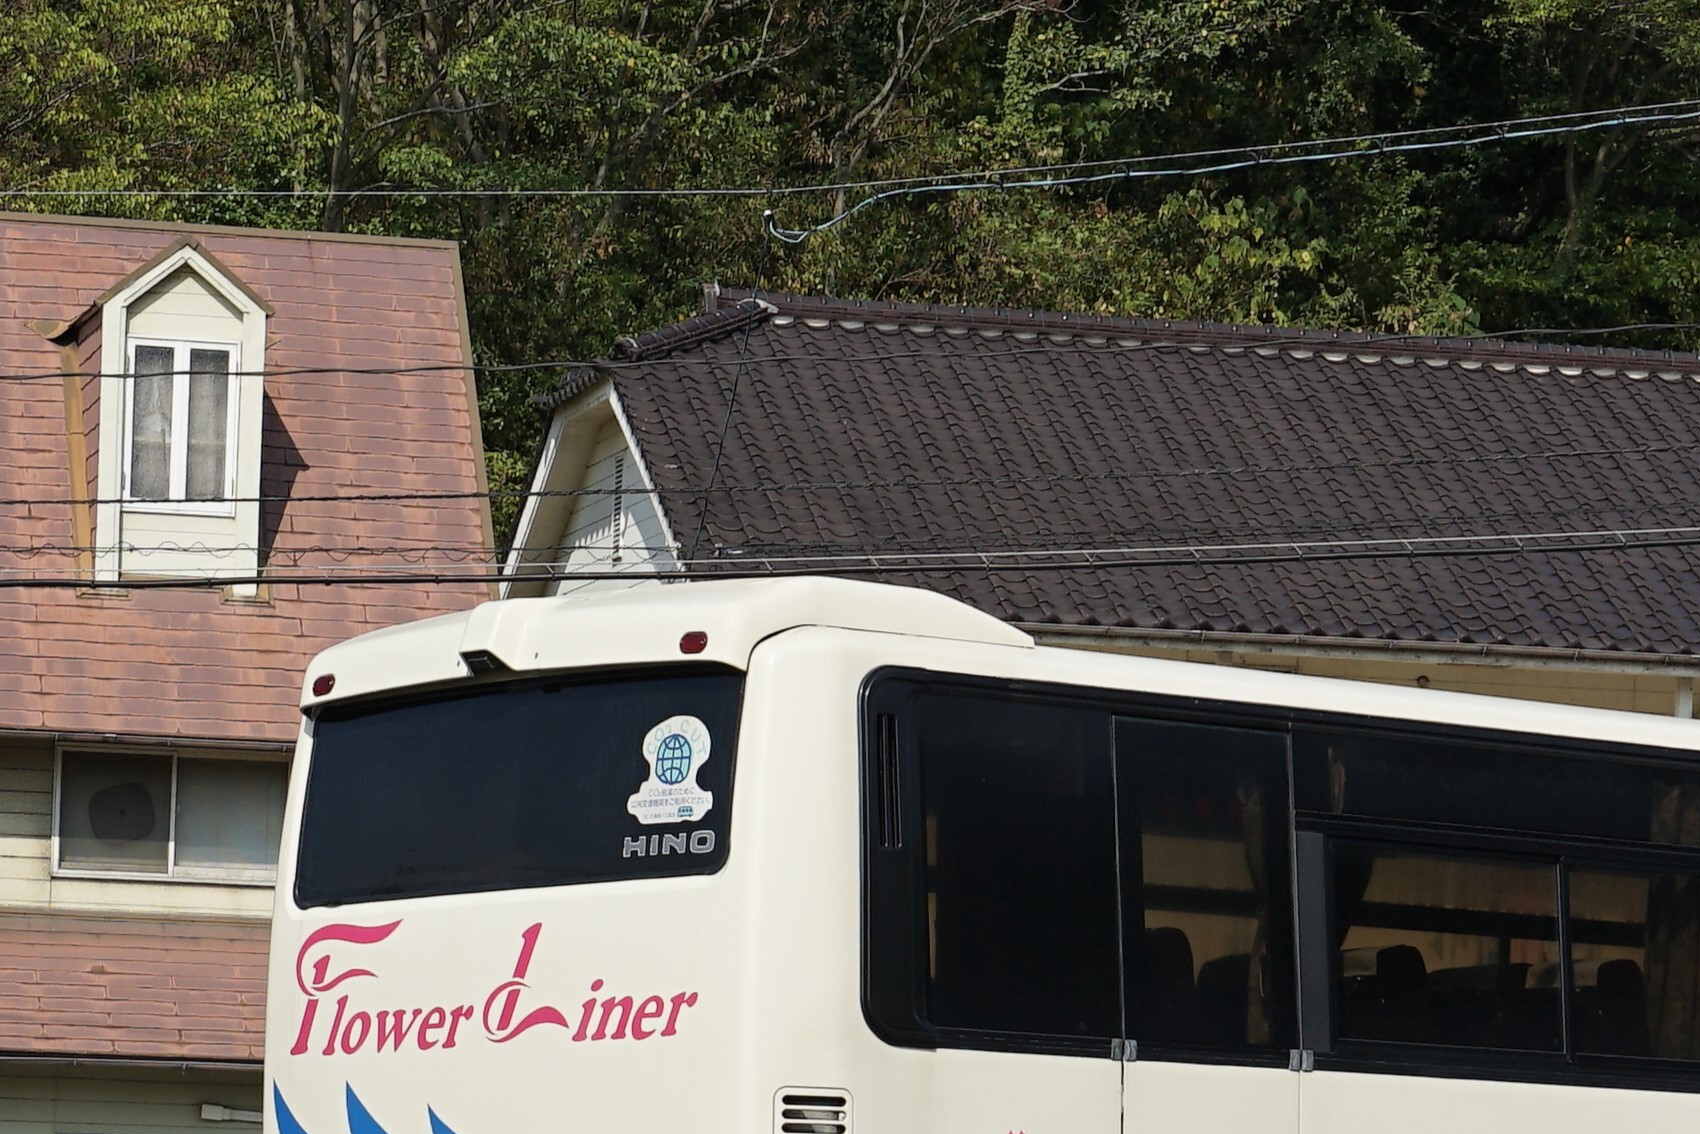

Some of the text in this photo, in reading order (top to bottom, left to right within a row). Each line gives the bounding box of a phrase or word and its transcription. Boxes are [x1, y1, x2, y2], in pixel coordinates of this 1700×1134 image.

[680, 719, 708, 755] CUT
[623, 830, 716, 858] HINO
[290, 918, 699, 1057] Flower Liner
